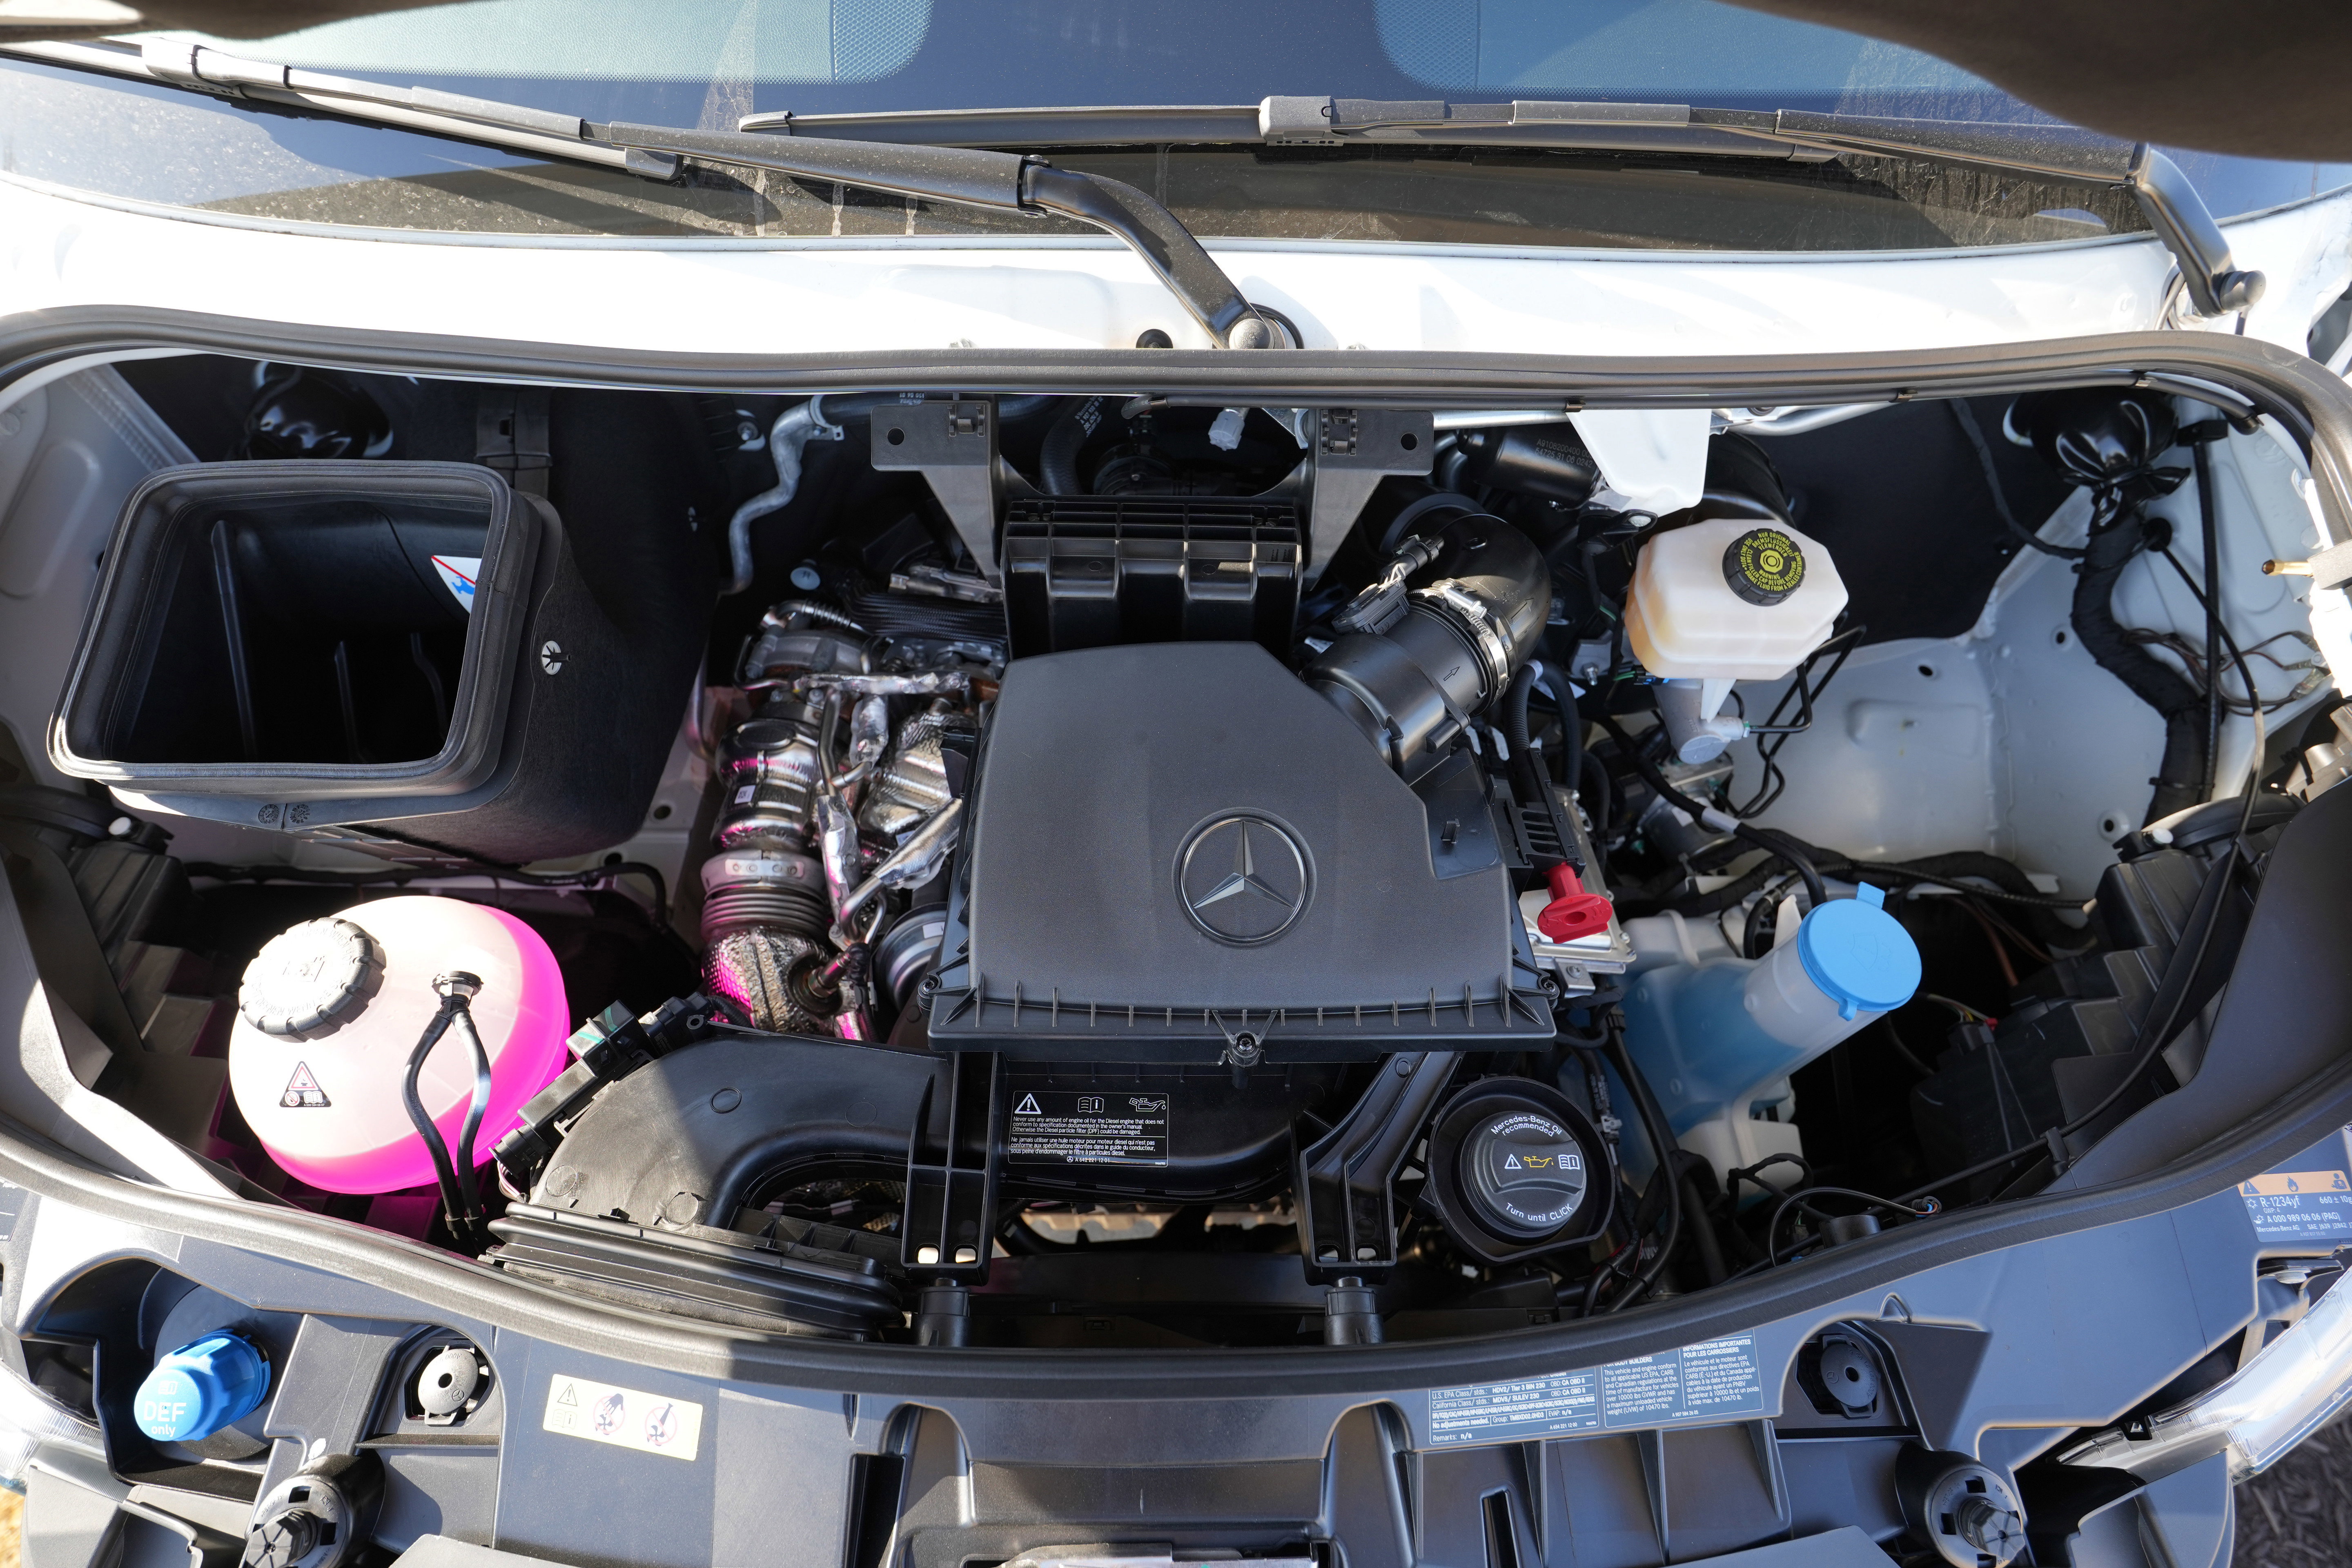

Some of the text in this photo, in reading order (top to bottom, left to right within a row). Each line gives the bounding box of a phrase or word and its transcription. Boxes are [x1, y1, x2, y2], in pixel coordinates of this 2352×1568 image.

[1535, 448, 1555, 459] 54725
[1577, 458, 1592, 468] 0242
[1770, 532, 1791, 546] ORIGINAL
[1758, 543, 1788, 557] VERWENDEN
[1745, 570, 1758, 584] BRAKE
[1757, 581, 1770, 590] FLUID
[1786, 575, 1800, 588] SEALED
[1794, 551, 1802, 576] CONTAINER
[1748, 564, 1760, 578] FILLER
[1784, 561, 1797, 582] REMOVING
[1758, 569, 1780, 580] WARNING
[1491, 1116, 1562, 1135] Mercedes-Benz Oil
[1502, 1123, 1555, 1137] recommended
[2259, 1196, 2300, 1208] R-1234yf
[1506, 1203, 1573, 1222] Turn until CLICK
[2322, 1212, 2341, 1222] (PAG)
[1682, 1339, 1751, 1351] INFORMATIONS IMPORTANTES
[1706, 1347, 1739, 1355] CARROSSIERS
[1455, 1389, 1472, 1398] Class/
[1432, 1400, 1457, 1410] California
[1457, 1399, 1474, 1408] Class/
[143, 1401, 187, 1422] DEF
[1607, 1408, 1623, 1416] weight
[1624, 1406, 1638, 1414] (UVW)
[1441, 1419, 1469, 1429] adjustments
[1470, 1417, 1489, 1425] needed.
[1492, 1415, 1508, 1424] Group:
[151, 1424, 176, 1437] only
[1433, 1432, 1472, 1442] Remarks: n/a
